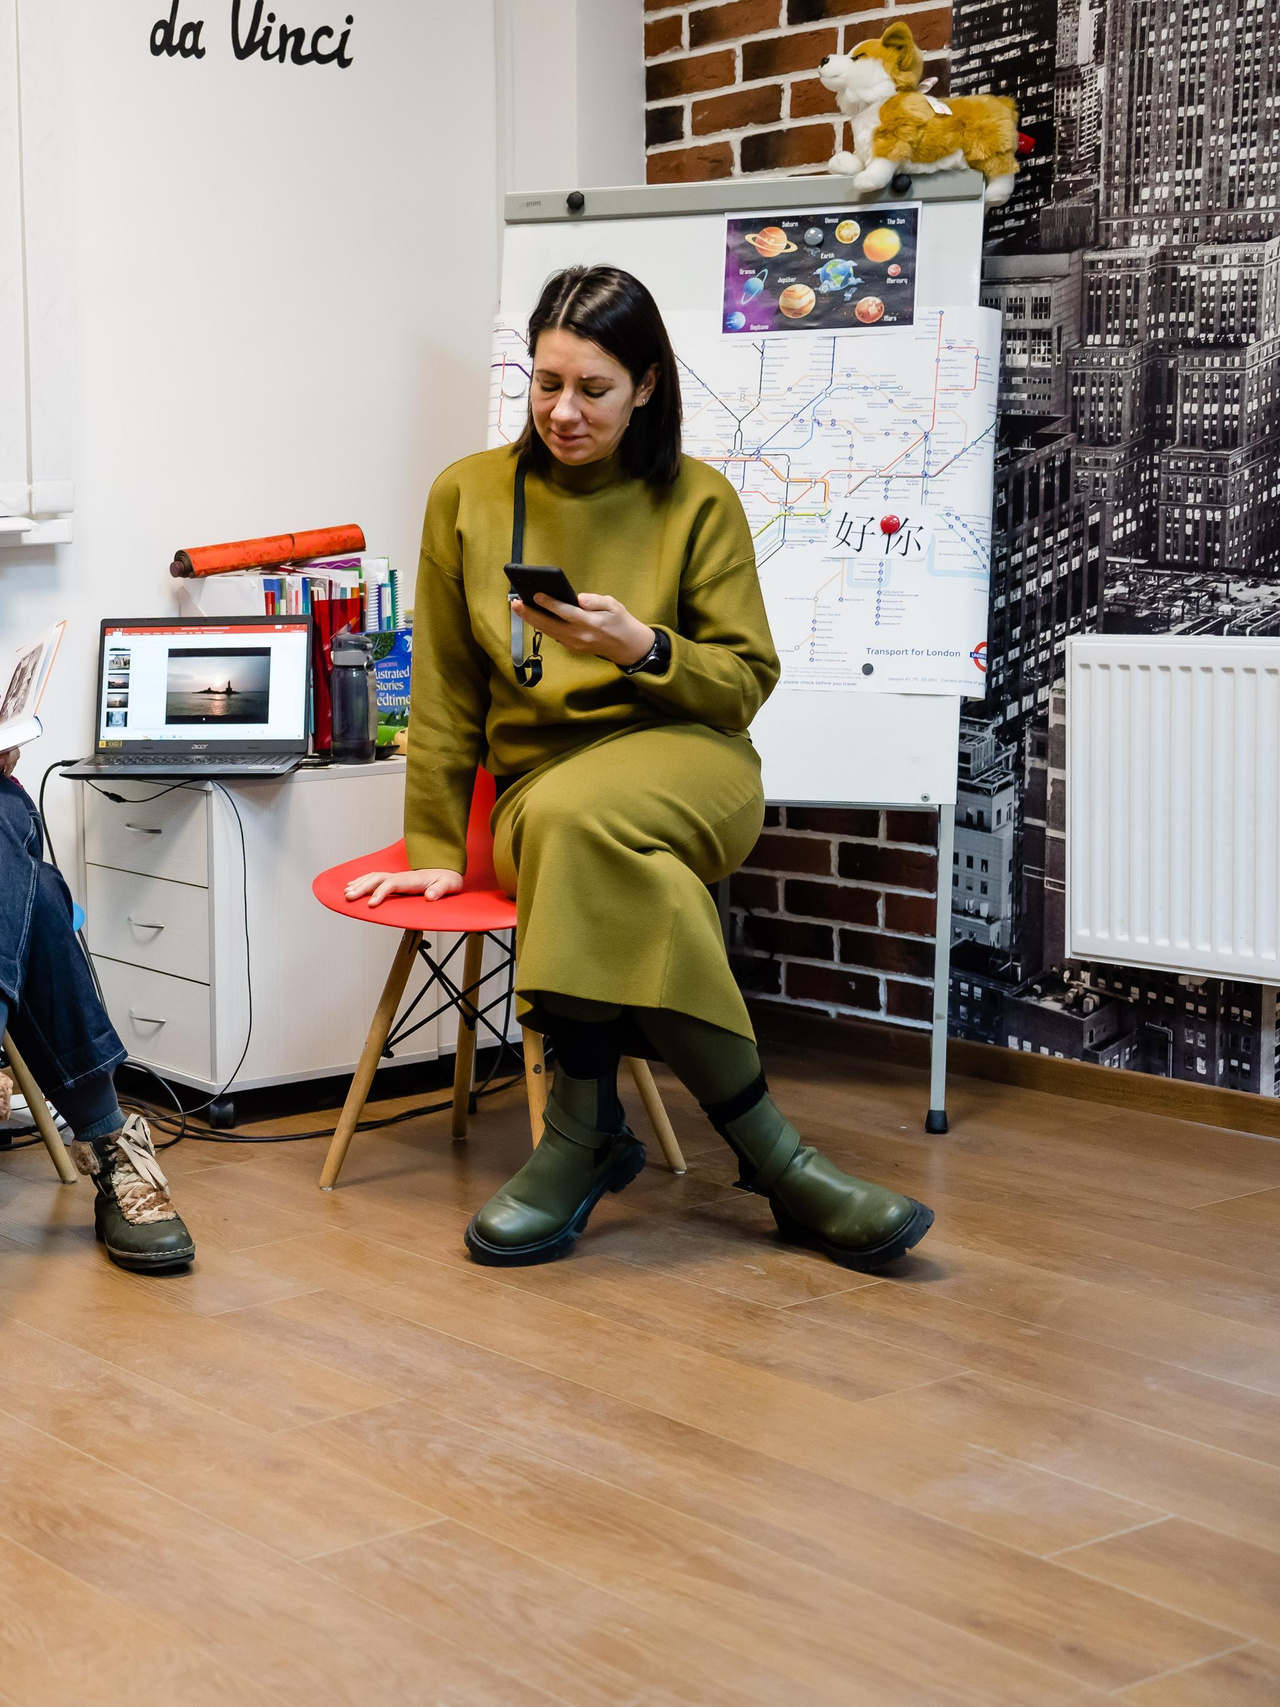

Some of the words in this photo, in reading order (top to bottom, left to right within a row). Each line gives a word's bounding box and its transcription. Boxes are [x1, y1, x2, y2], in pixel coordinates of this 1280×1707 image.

[149, 0, 206, 59] da
[230, 0, 355, 69] Vinci
[824, 217, 839, 225] Venus
[777, 276, 797, 284] Jupiter
[886, 277, 908, 285] Mercury
[866, 647, 909, 657] Transport
[911, 648, 925, 656] for
[926, 648, 961, 657] London
[376, 680, 405, 692] Stories
